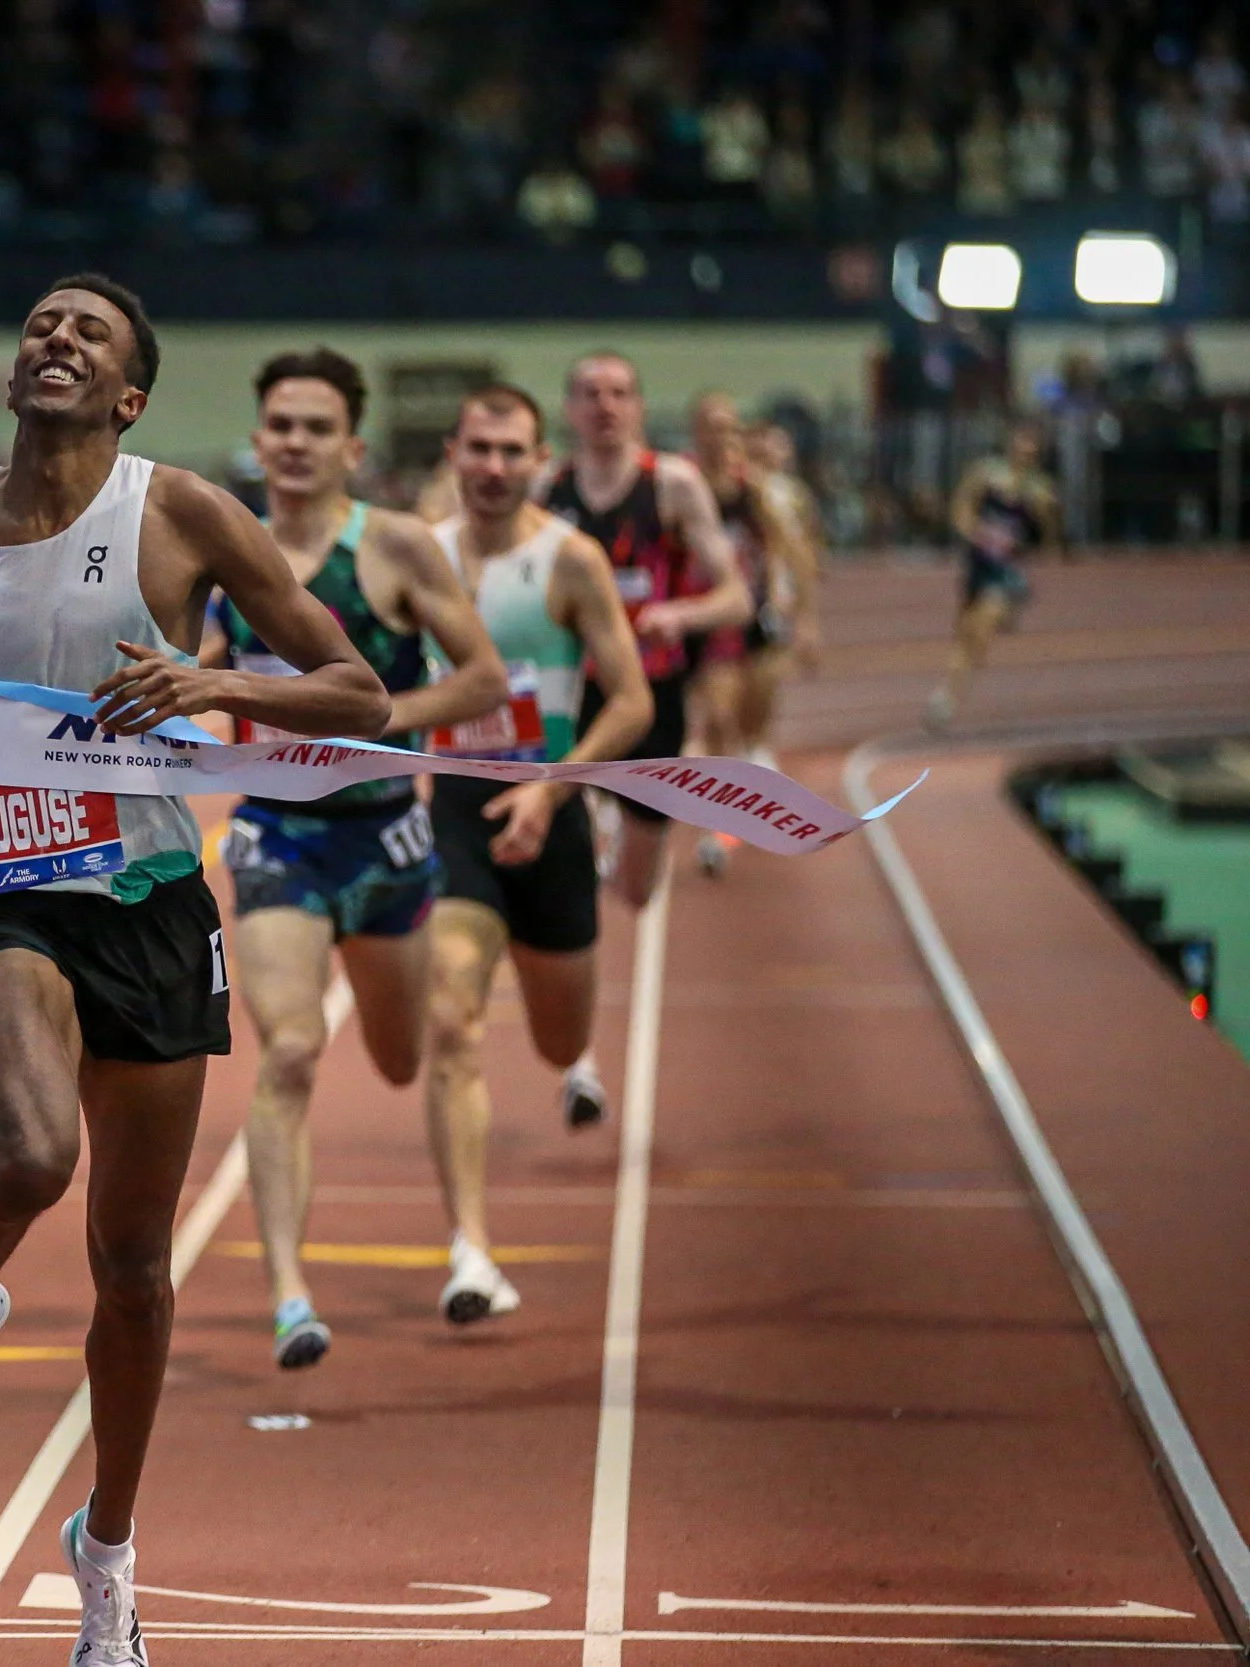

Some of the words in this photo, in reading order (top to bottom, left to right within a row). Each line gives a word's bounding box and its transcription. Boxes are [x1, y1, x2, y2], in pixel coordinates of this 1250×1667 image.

[44, 751, 78, 763] NEW
[83, 753, 121, 766] YORK
[126, 755, 161, 768] ROAD
[627, 765, 821, 840] WANAMAKER
[9, 873, 40, 885] ARMORY
[16, 868, 31, 876] THE
